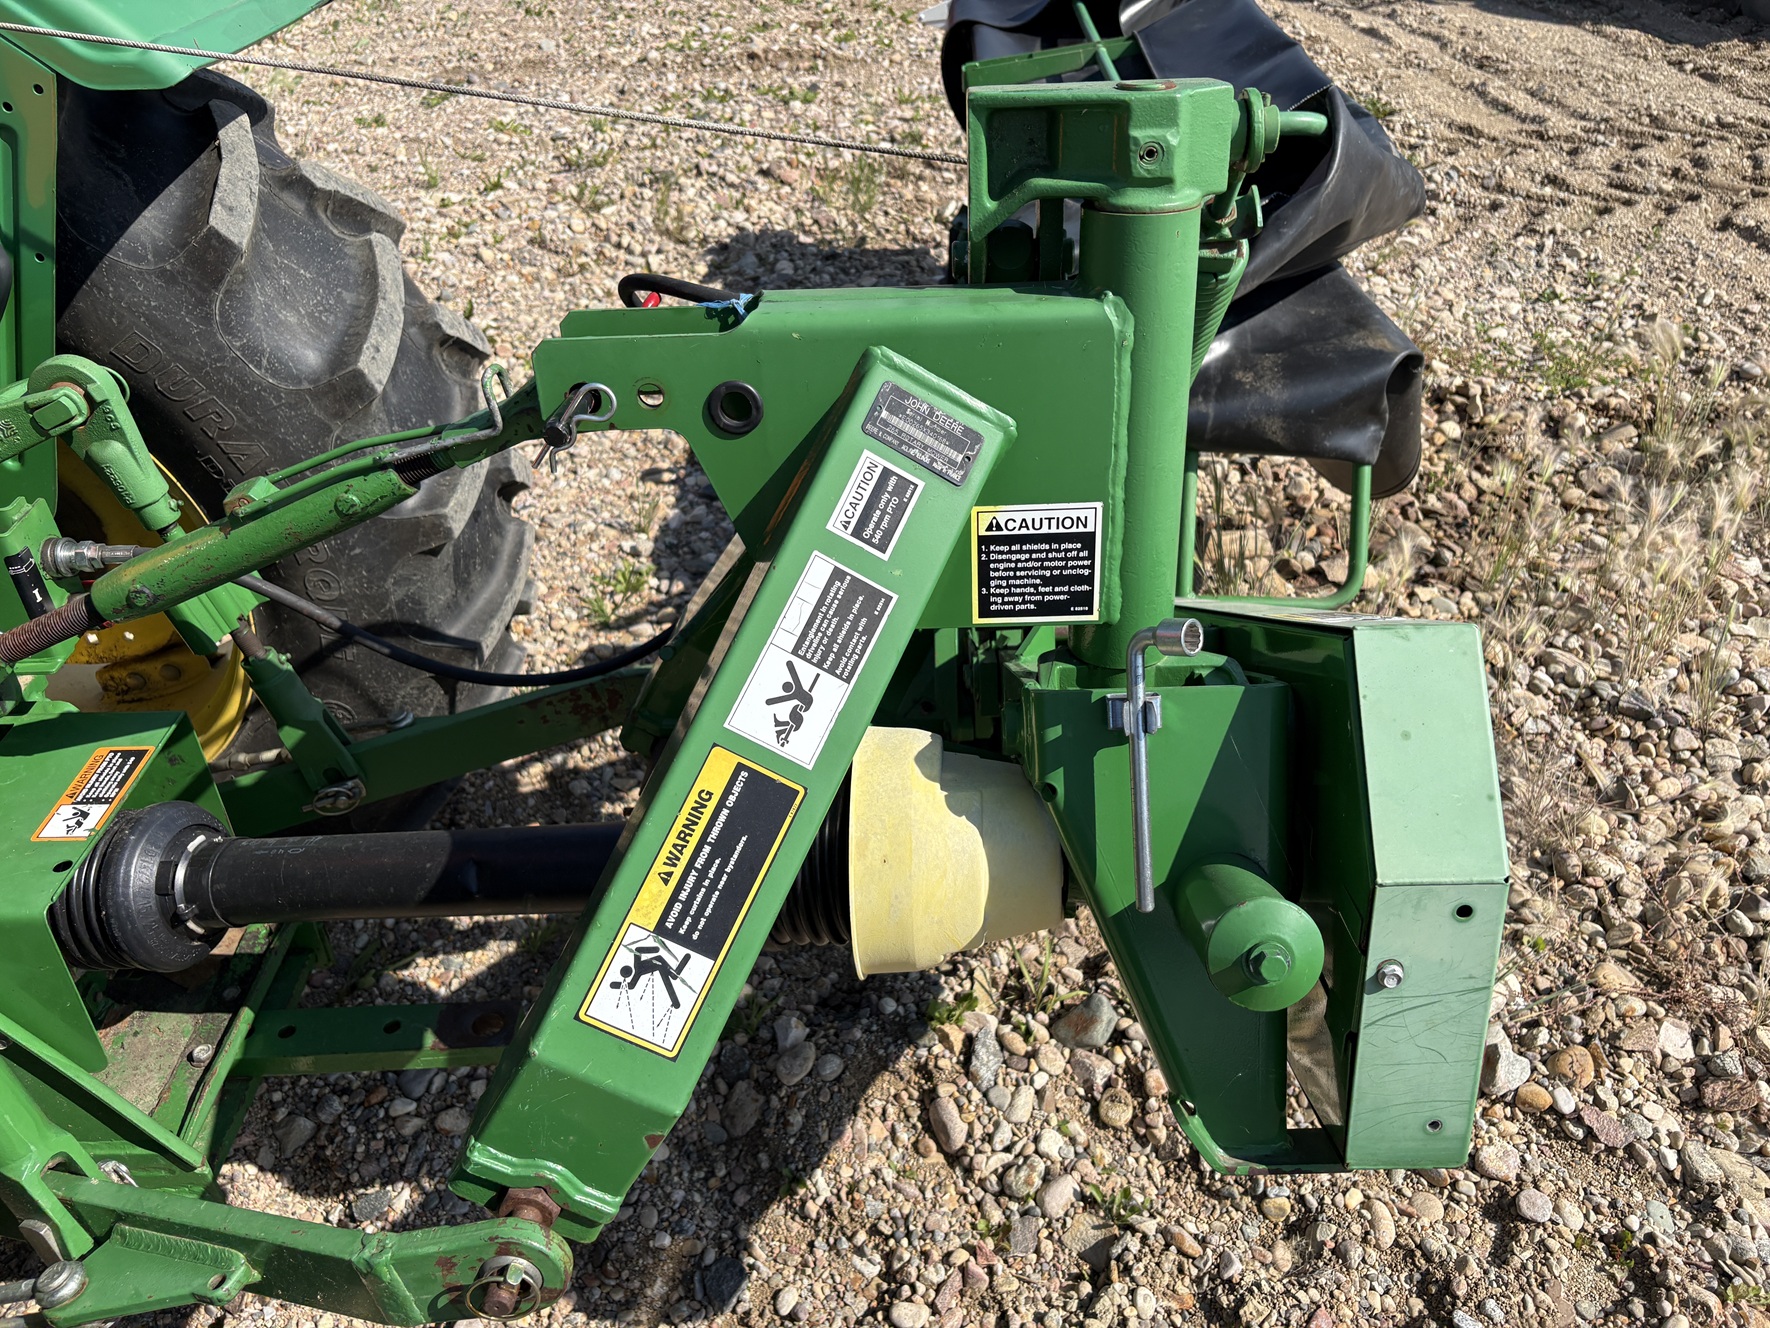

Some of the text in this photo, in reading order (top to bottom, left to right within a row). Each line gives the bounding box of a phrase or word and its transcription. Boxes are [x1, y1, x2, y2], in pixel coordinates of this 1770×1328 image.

[109, 330, 268, 475] DURA
[905, 396, 964, 434] JOHN DEERE
[905, 408, 923, 422] Serial
[886, 423, 949, 463] 265 ROTARY MOWER
[844, 462, 878, 519] CAUTION
[863, 476, 898, 538] Operate only with
[872, 497, 899, 544] 540 rpm PTO
[1004, 516, 1088, 531] CAUTION
[990, 562, 1015, 570] engine
[1022, 543, 1050, 551] shields
[1061, 542, 1081, 550] place
[1016, 569, 1050, 577] servicing
[1063, 568, 1091, 576] unclog-
[798, 612, 824, 656] Entanglement
[825, 581, 841, 605] rotating
[806, 575, 851, 659] driveline can cause serious
[1044, 594, 1070, 602] power-
[811, 617, 839, 663] injury or death.
[823, 653, 835, 669] Keep
[837, 621, 851, 643] shields
[852, 595, 864, 614] place.
[835, 618, 867, 675] Avoid contact with
[842, 635, 867, 679] rotating parts.
[69, 754, 104, 791] WARNING
[663, 789, 714, 867] WARNING
[665, 771, 748, 929] AVOID INJURY FROM THROWN OBJECTS
[678, 917, 691, 934] Keep
[690, 888, 706, 915] curtains
[708, 858, 721, 878] place.
[692, 835, 748, 940] do not operate near bystanders.
